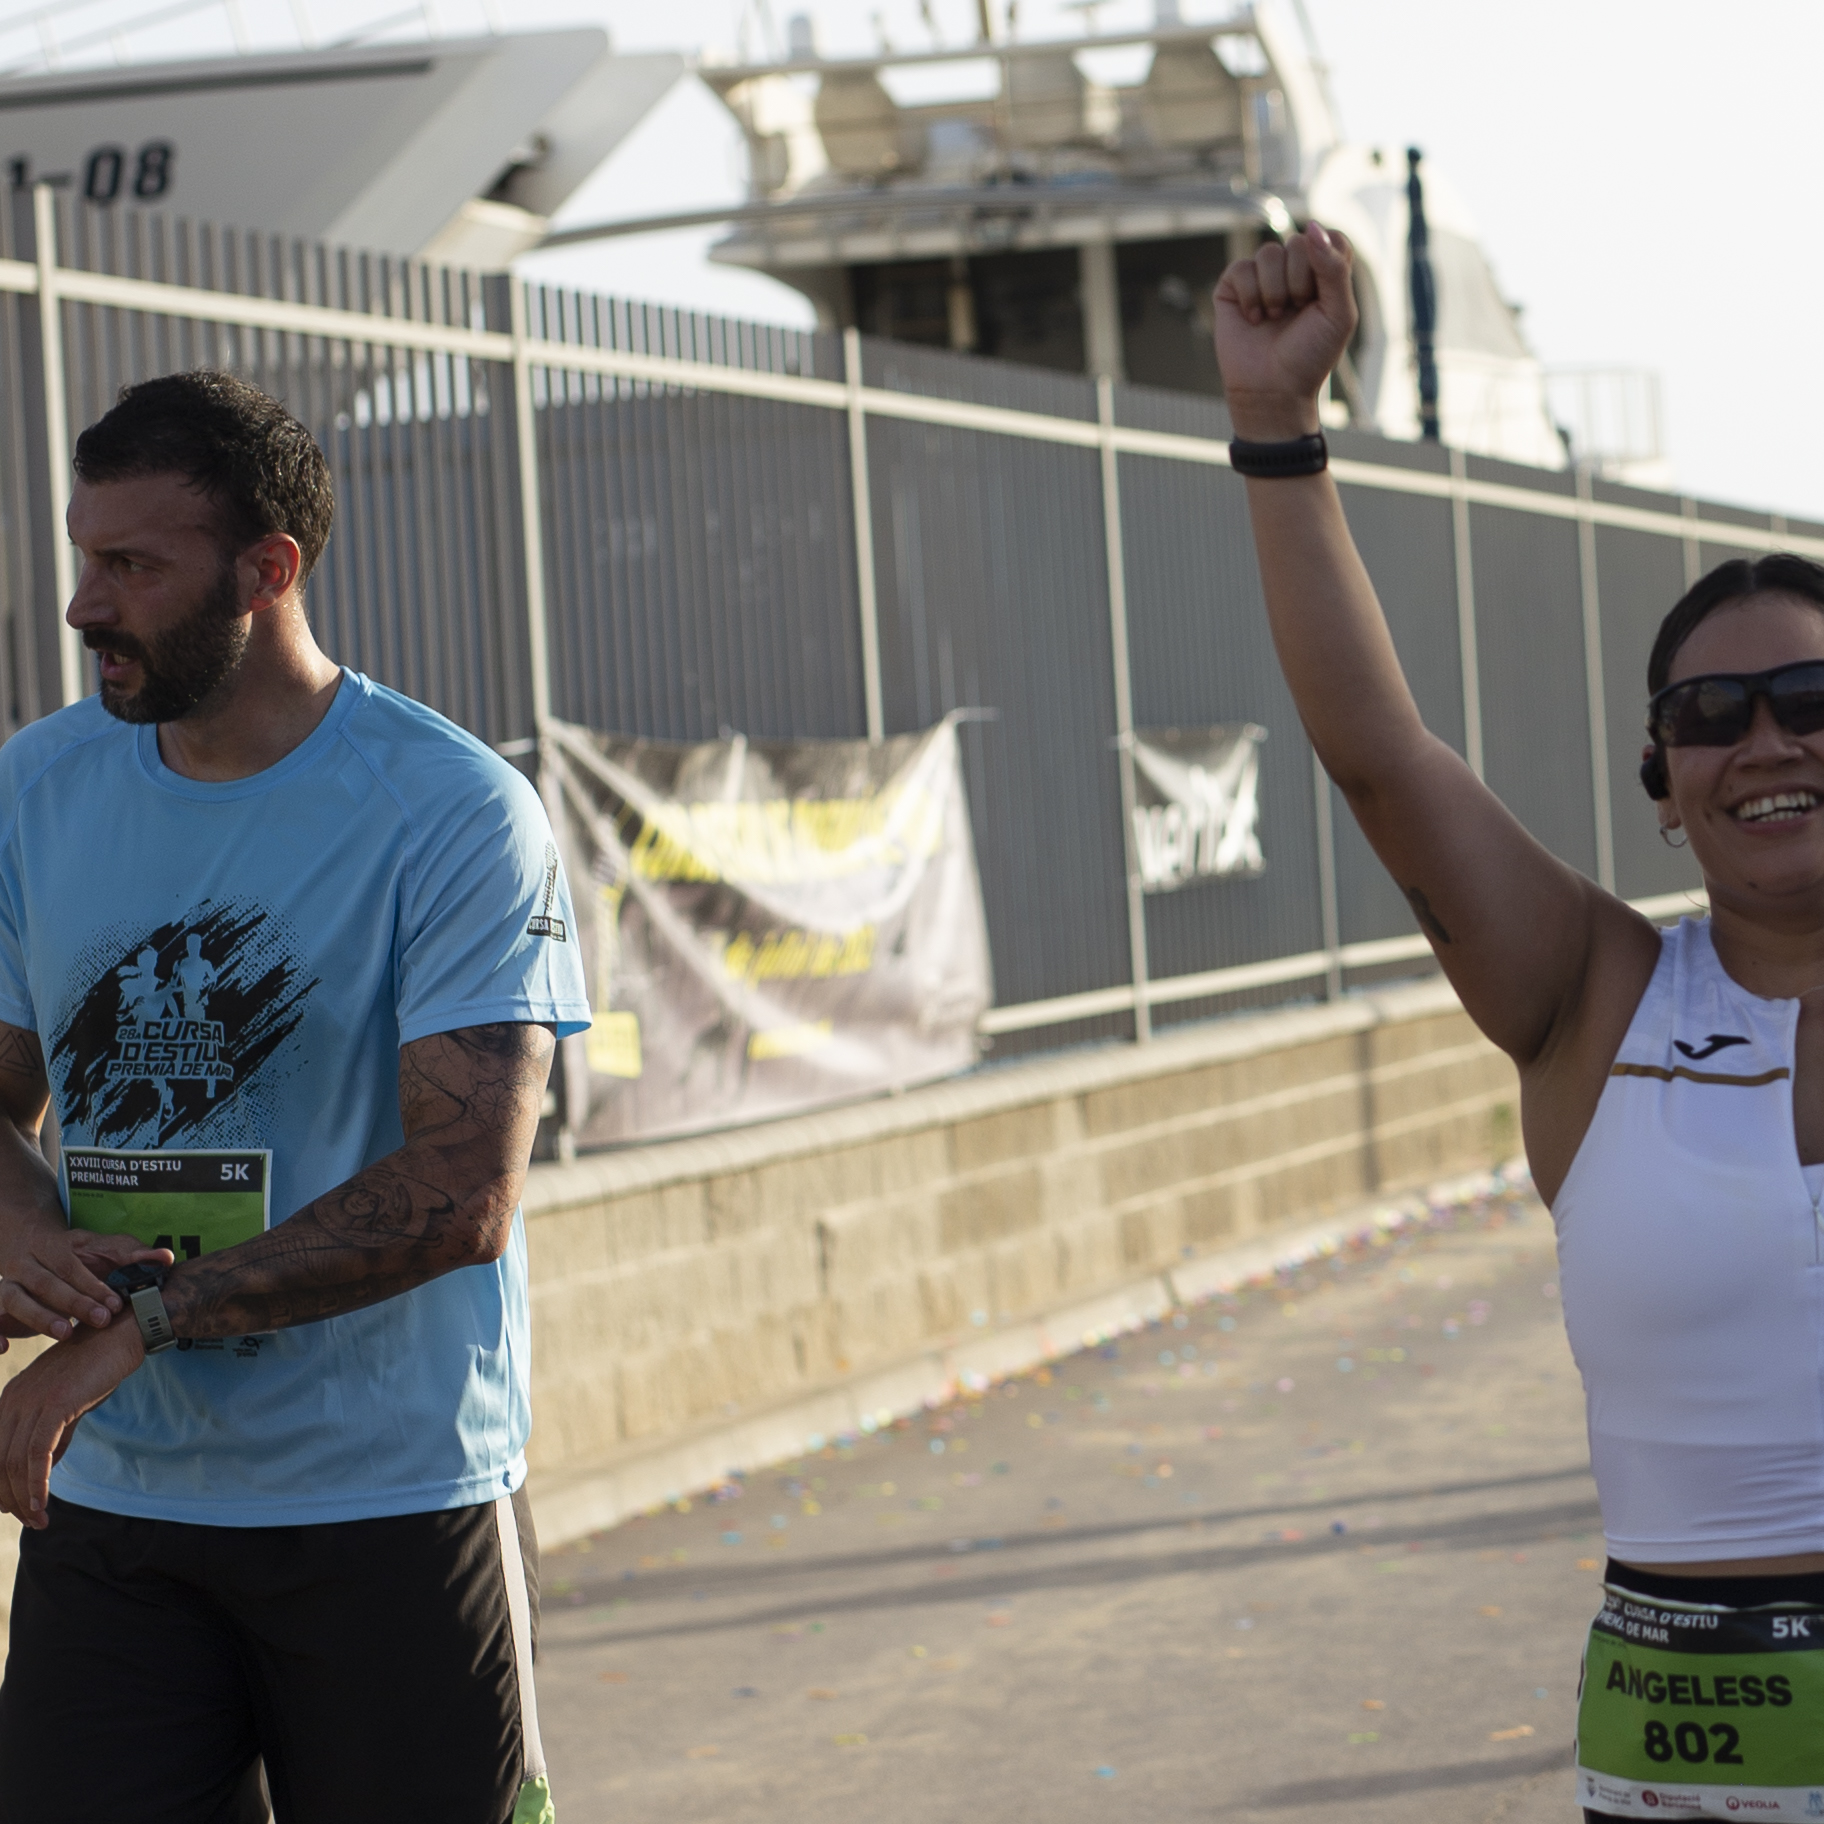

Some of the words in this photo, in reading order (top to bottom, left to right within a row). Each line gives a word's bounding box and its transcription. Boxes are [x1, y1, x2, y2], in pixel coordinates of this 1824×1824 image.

[142, 1021, 223, 1044] CURSA
[122, 1042, 217, 1062] D'ESTIU
[179, 1063, 204, 1076] DE
[69, 1156, 100, 1169] XXVIII
[102, 1158, 126, 1171] CURSA
[130, 1159, 182, 1172] D'ESTIU
[220, 1163, 249, 1181] 5K
[106, 1174, 115, 1185] DE
[116, 1174, 139, 1186] MAR
[1659, 1610, 1719, 1630] D'ESTIU
[1771, 1615, 1811, 1639] 5K
[1642, 1625, 1670, 1644] MAR
[1605, 1659, 1793, 1708] ANGELESS
[1643, 1719, 1744, 1766] 802
